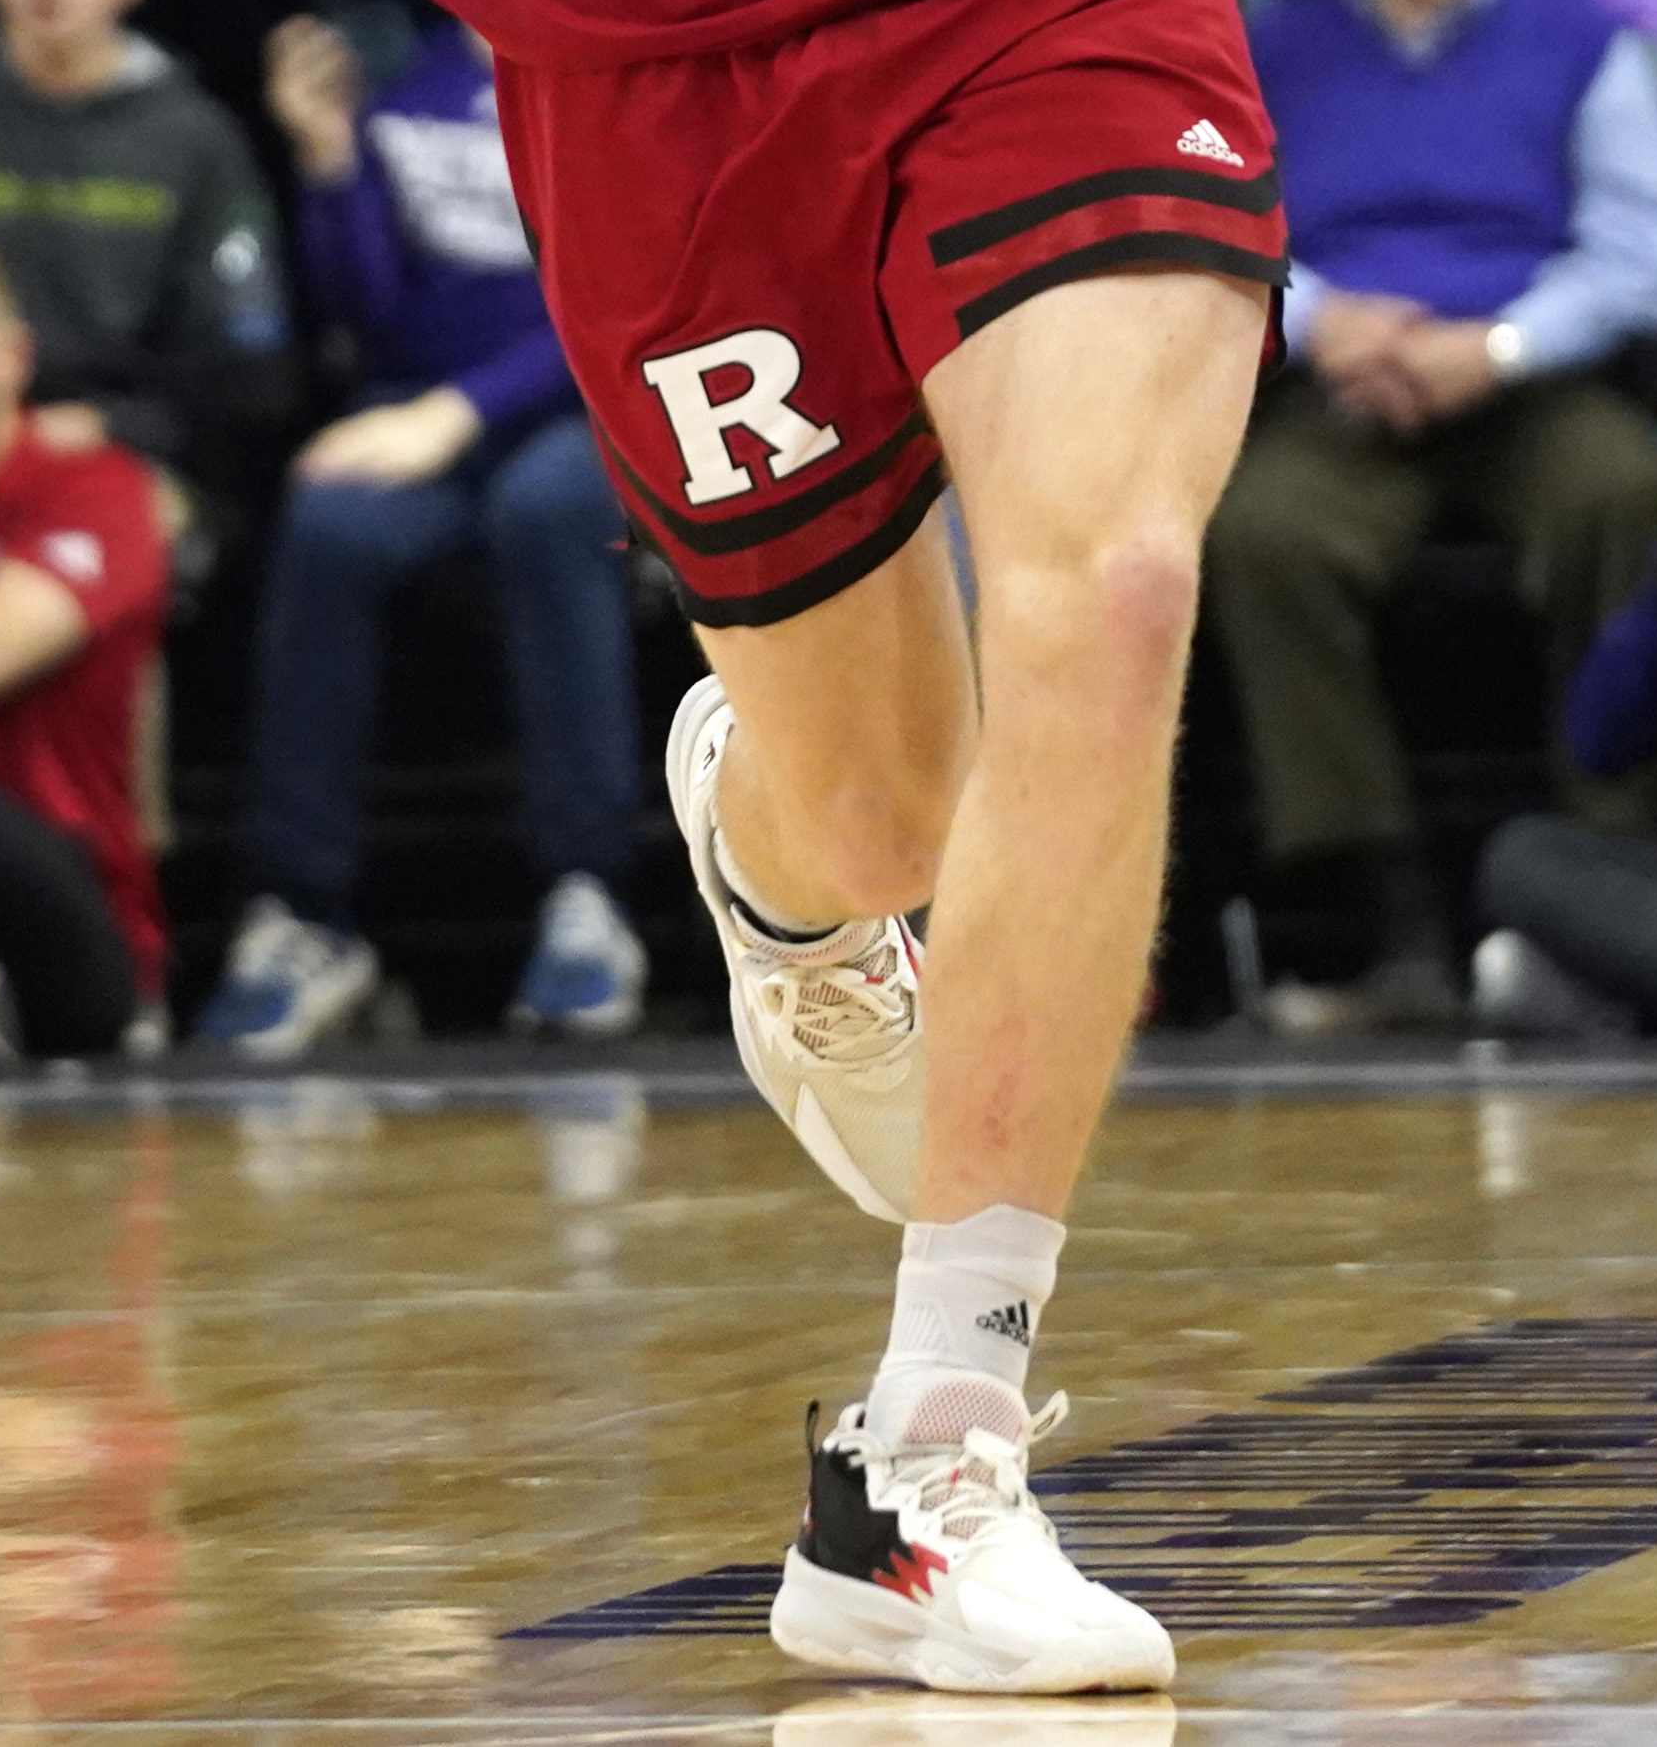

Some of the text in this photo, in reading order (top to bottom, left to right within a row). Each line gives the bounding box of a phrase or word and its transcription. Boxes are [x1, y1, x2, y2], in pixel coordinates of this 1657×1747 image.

[1176, 137, 1244, 168] adidas
[642, 326, 842, 507] R
[975, 1313, 1030, 1347] adida
